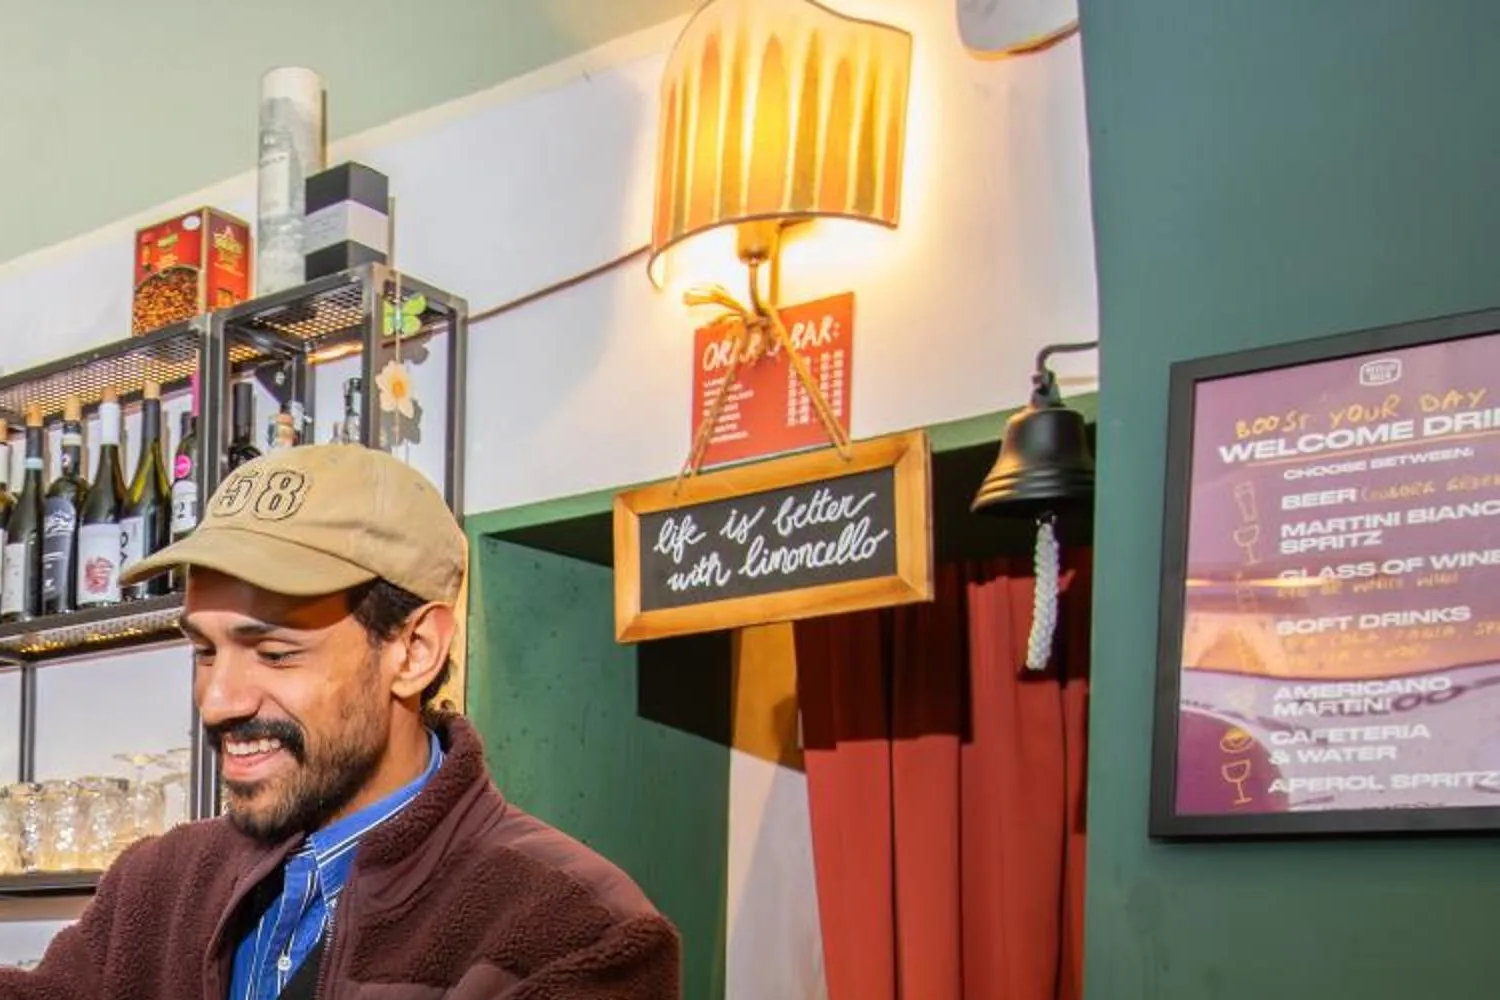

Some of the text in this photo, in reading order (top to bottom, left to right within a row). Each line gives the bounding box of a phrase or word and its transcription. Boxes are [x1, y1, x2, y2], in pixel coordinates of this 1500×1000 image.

[1330, 394, 1401, 428] YOUR
[1420, 387, 1486, 413] DAY
[1219, 406, 1500, 464] WELCOME DRI
[1283, 446, 1475, 480] CHOOSE BETWEEN:
[1281, 487, 1357, 510] BEER
[654, 488, 877, 564] life is better
[1280, 512, 1400, 538] MARTINI
[667, 515, 889, 591] with limoncello
[1279, 530, 1382, 554] SPRITZ
[1278, 561, 1376, 583] GLASS
[1381, 558, 1424, 576] OF
[1275, 615, 1353, 637] SOFT
[1358, 605, 1472, 630] DRINKS
[1273, 676, 1451, 702] AMERICANO
[1273, 696, 1393, 718] MARTINI
[1270, 723, 1431, 746] CAFETERIA
[1296, 745, 1397, 764] WATER
[1268, 770, 1500, 794] APEROL SPRITZ
